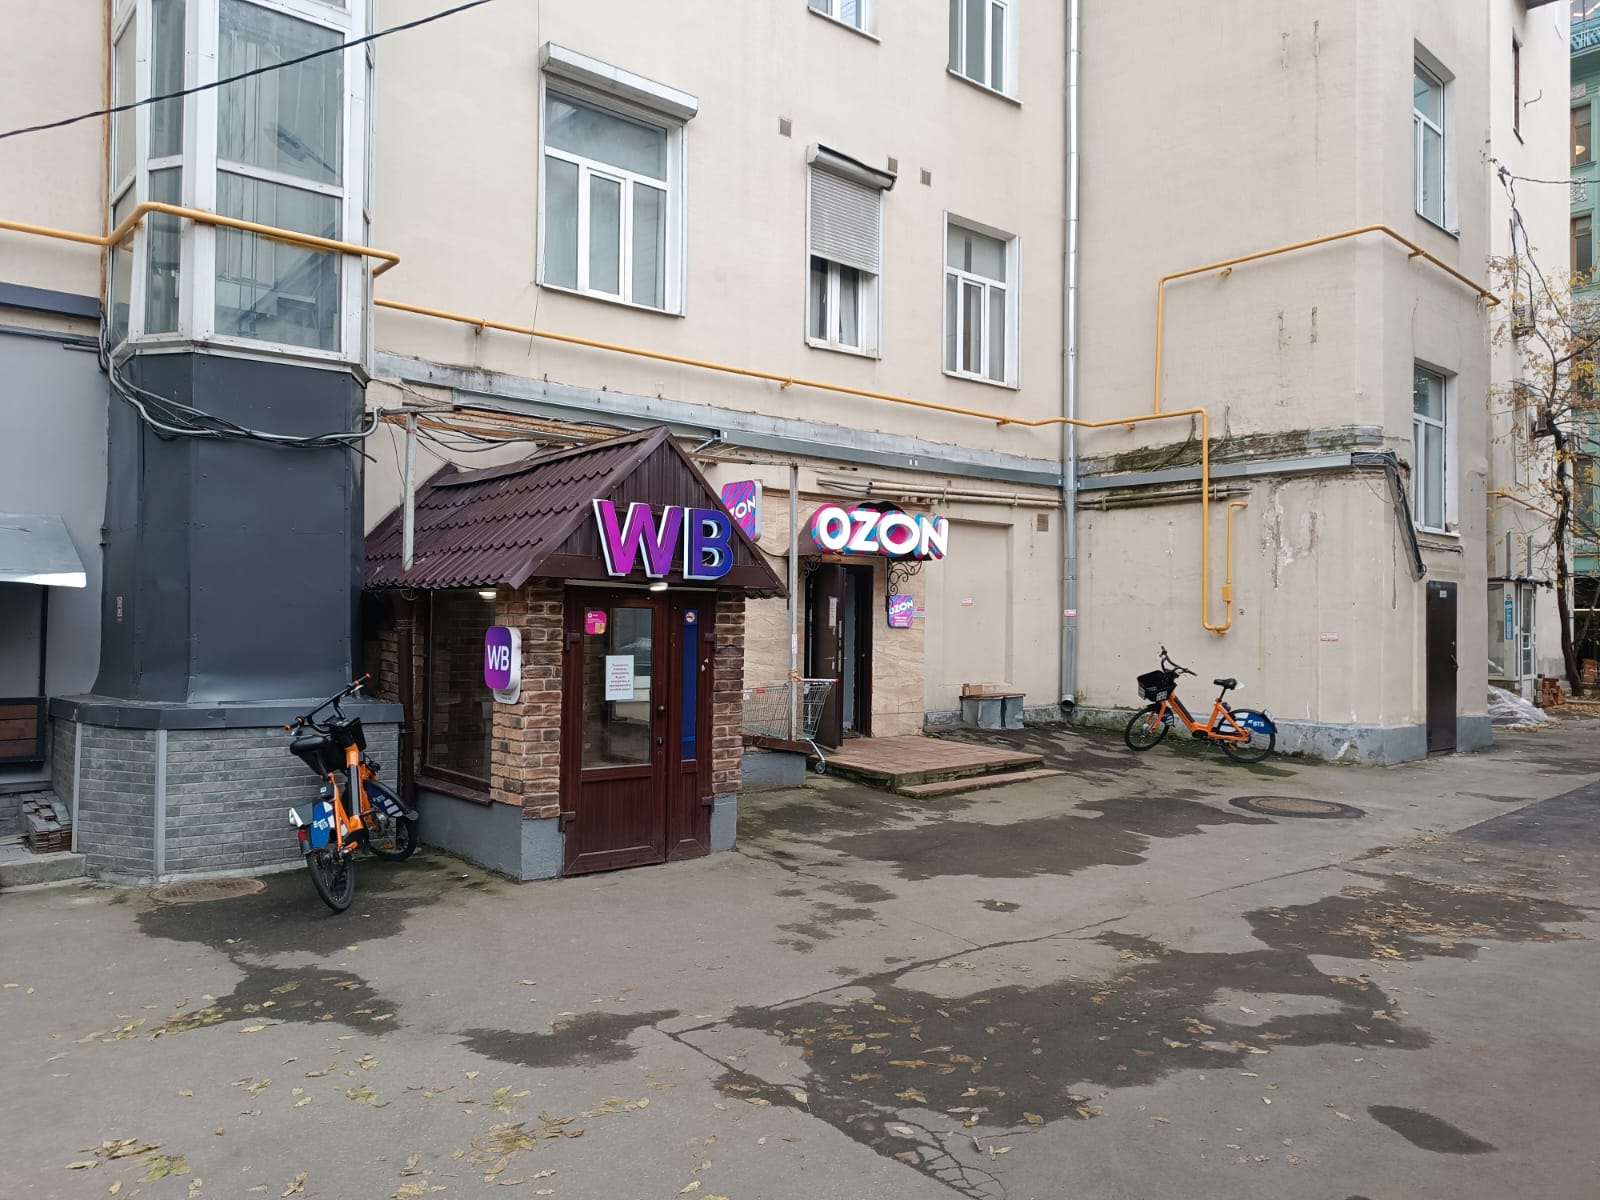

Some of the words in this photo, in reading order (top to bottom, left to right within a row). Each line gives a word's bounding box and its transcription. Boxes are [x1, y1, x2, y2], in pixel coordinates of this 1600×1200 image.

[592, 498, 734, 580] WB
[812, 504, 949, 559] OZON
[888, 599, 913, 615] OZON
[487, 644, 510, 671] WB
